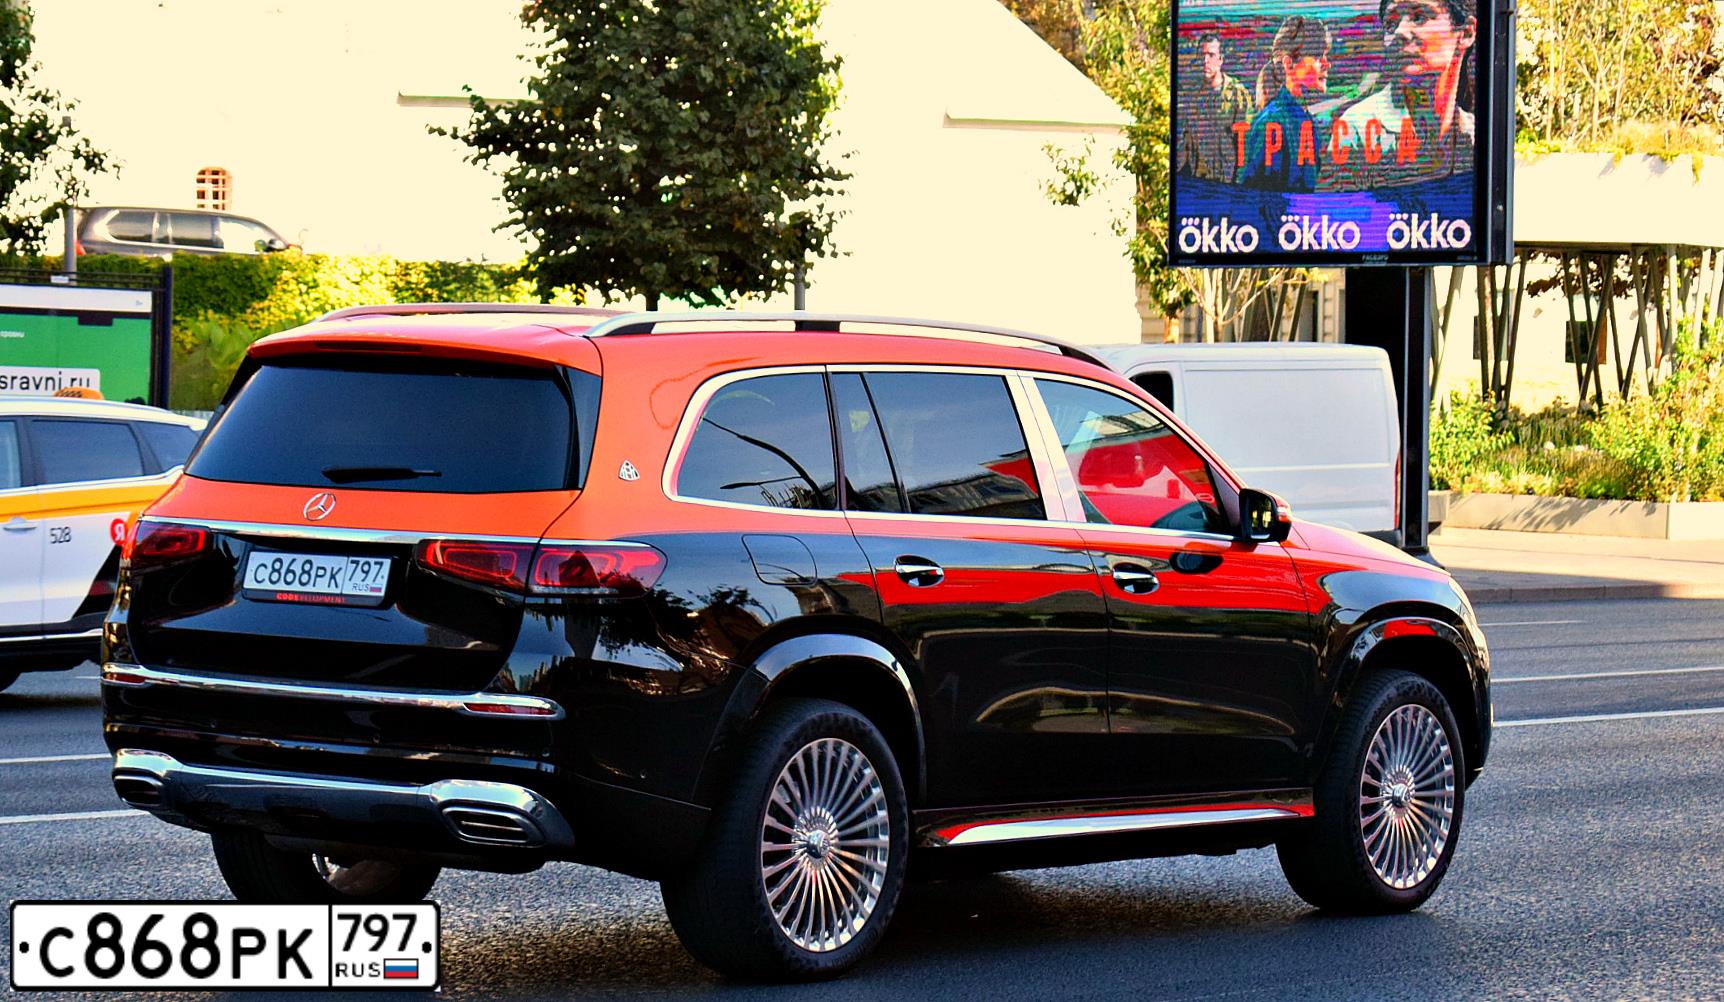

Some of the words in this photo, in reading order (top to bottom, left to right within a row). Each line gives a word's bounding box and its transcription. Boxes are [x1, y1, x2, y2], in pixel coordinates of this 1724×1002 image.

[1231, 117, 1419, 167] ТРАССА
[0, 371, 90, 390] sravniru
[50, 526, 72, 544] 528
[253, 557, 343, 588] С868РК
[348, 559, 384, 583] 797
[351, 583, 369, 592] RUS
